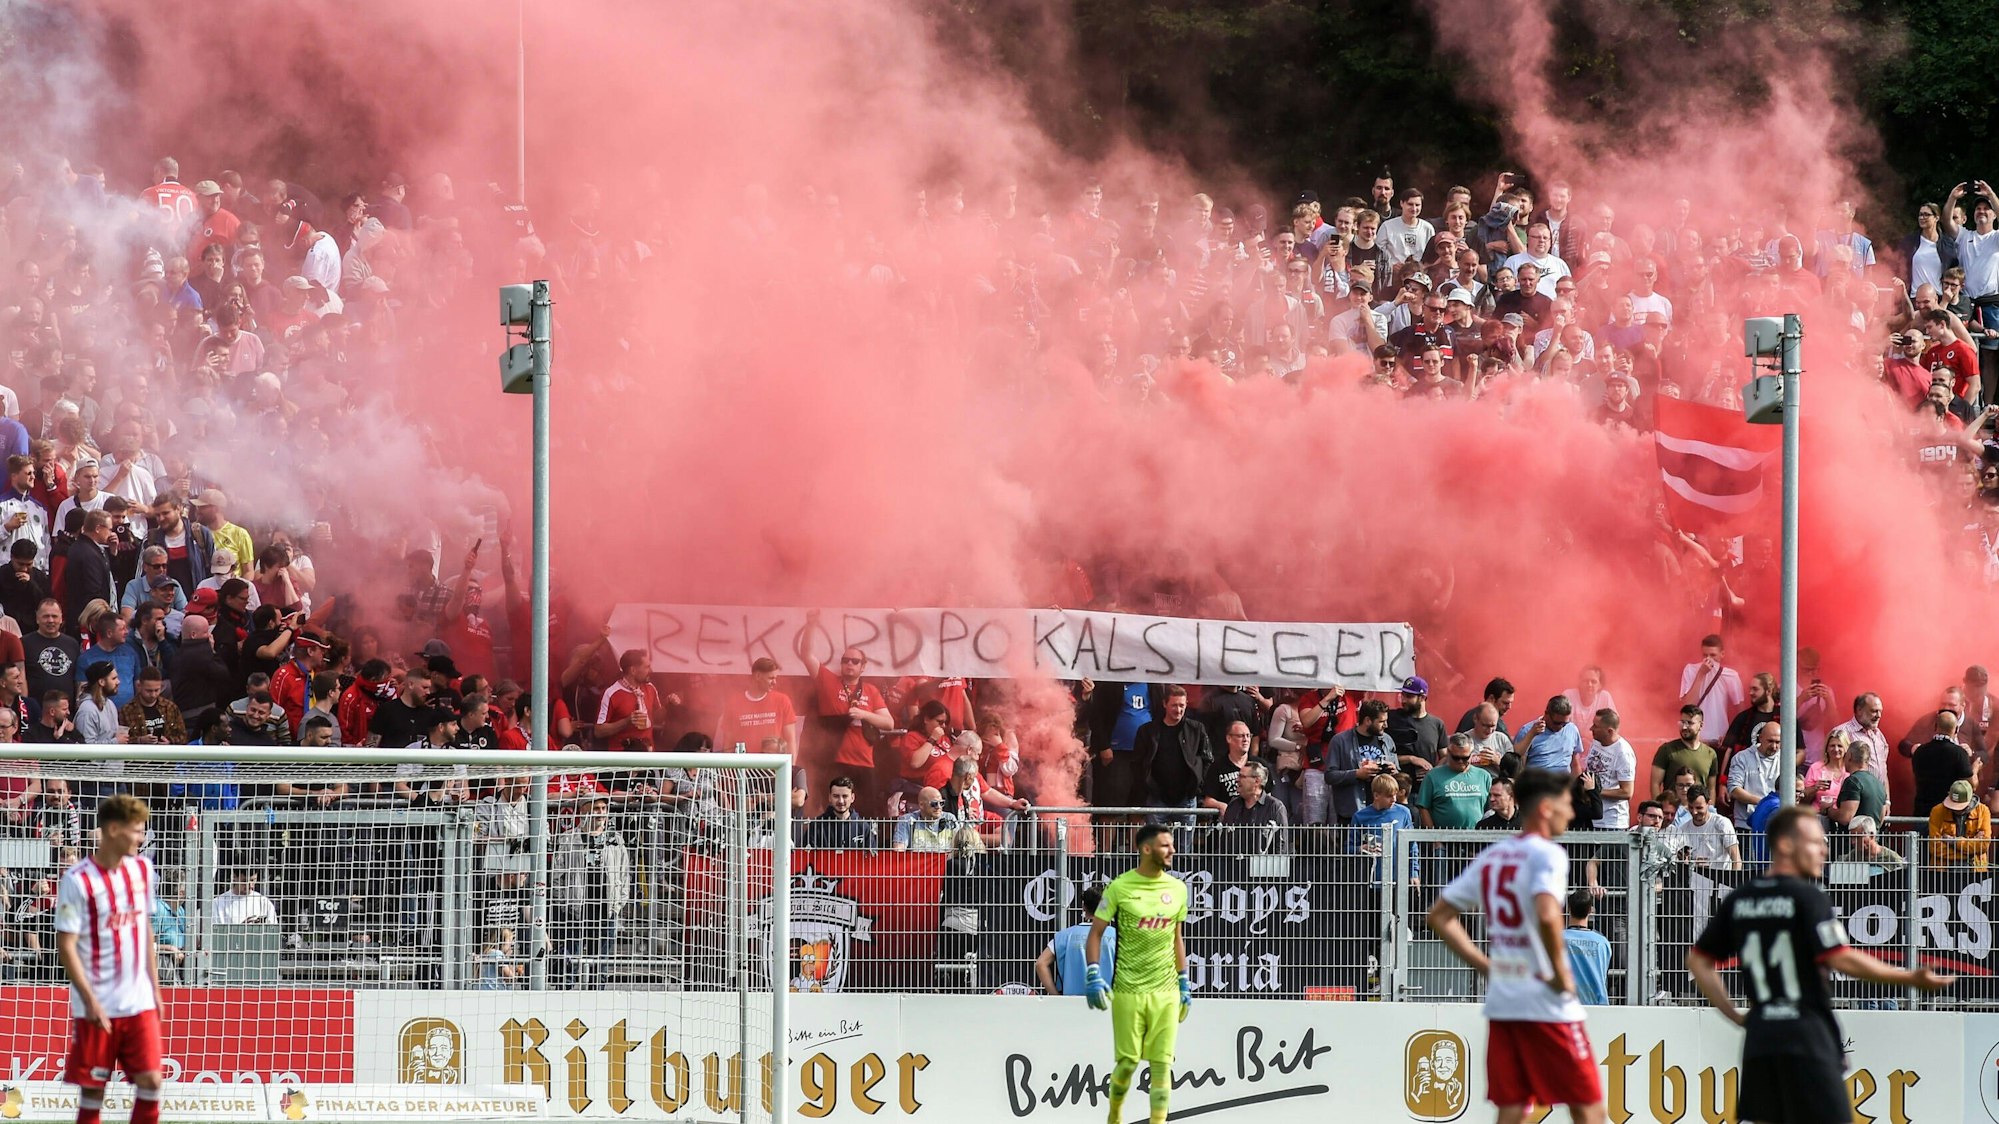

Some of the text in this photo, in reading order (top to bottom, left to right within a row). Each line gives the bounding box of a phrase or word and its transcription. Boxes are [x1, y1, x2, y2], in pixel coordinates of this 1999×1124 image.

[158, 192, 194, 223] 50
[1919, 445, 1957, 461] 1904
[1445, 780, 1481, 793] s.Oliver
[1480, 863, 1523, 929] 15
[318, 900, 340, 911] Tor
[322, 913, 339, 924] 37
[1138, 915, 1172, 929] HIT
[1741, 930, 1801, 1002] 11
[840, 1019, 863, 1035] Bit
[1236, 1025, 1332, 1082] Bit
[316, 1099, 537, 1113] FINALTAG DER AMATEURE
